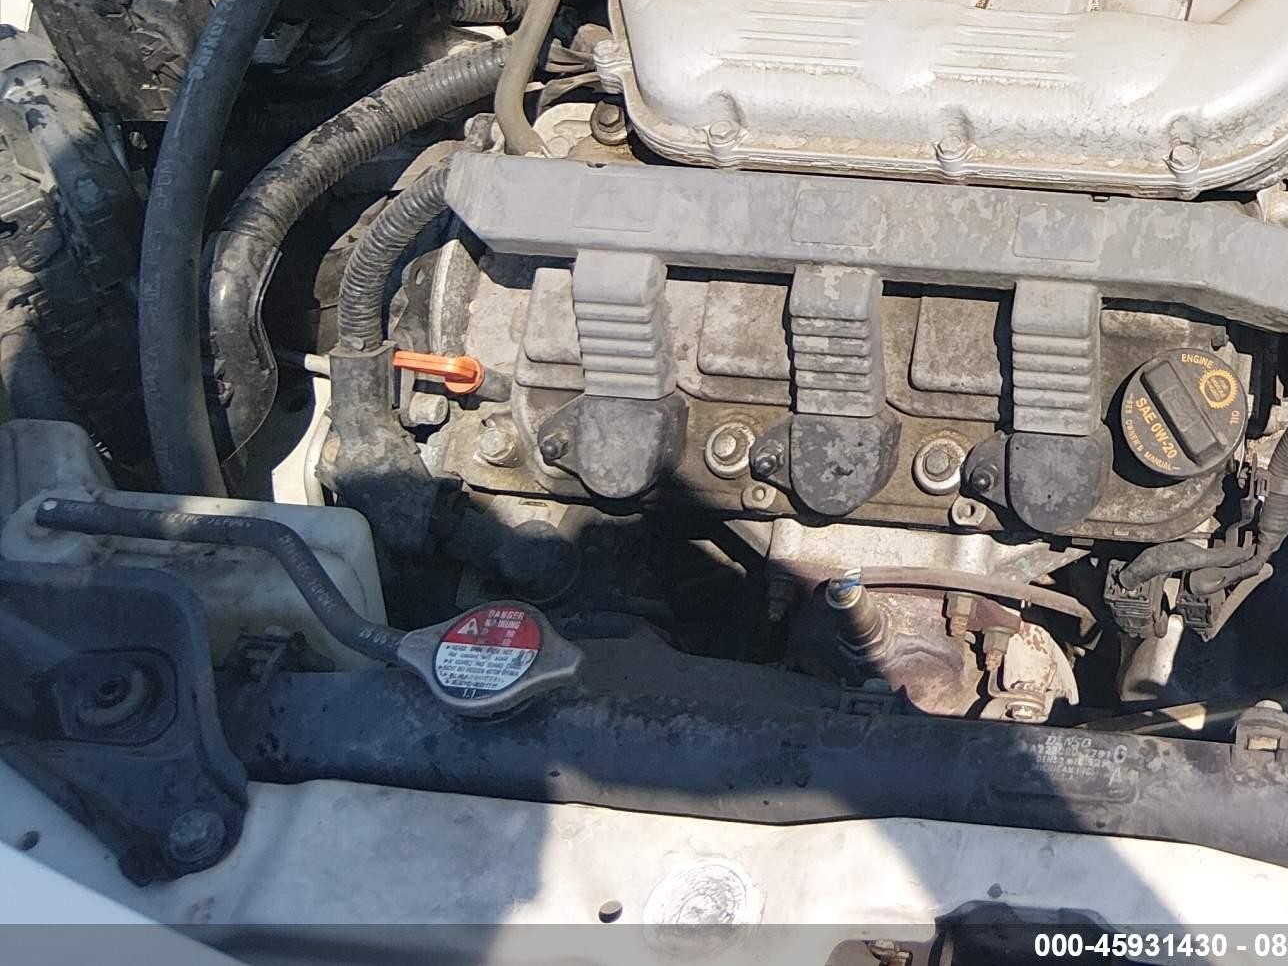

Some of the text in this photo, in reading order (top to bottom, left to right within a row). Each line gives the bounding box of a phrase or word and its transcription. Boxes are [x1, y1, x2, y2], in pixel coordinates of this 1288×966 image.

[1181, 353, 1215, 369] ENGINE
[1229, 410, 1241, 426] OIL
[1135, 397, 1178, 459] SAE 0W-20
[488, 609, 525, 620] DANGER
[484, 618, 522, 629] WRNUNG
